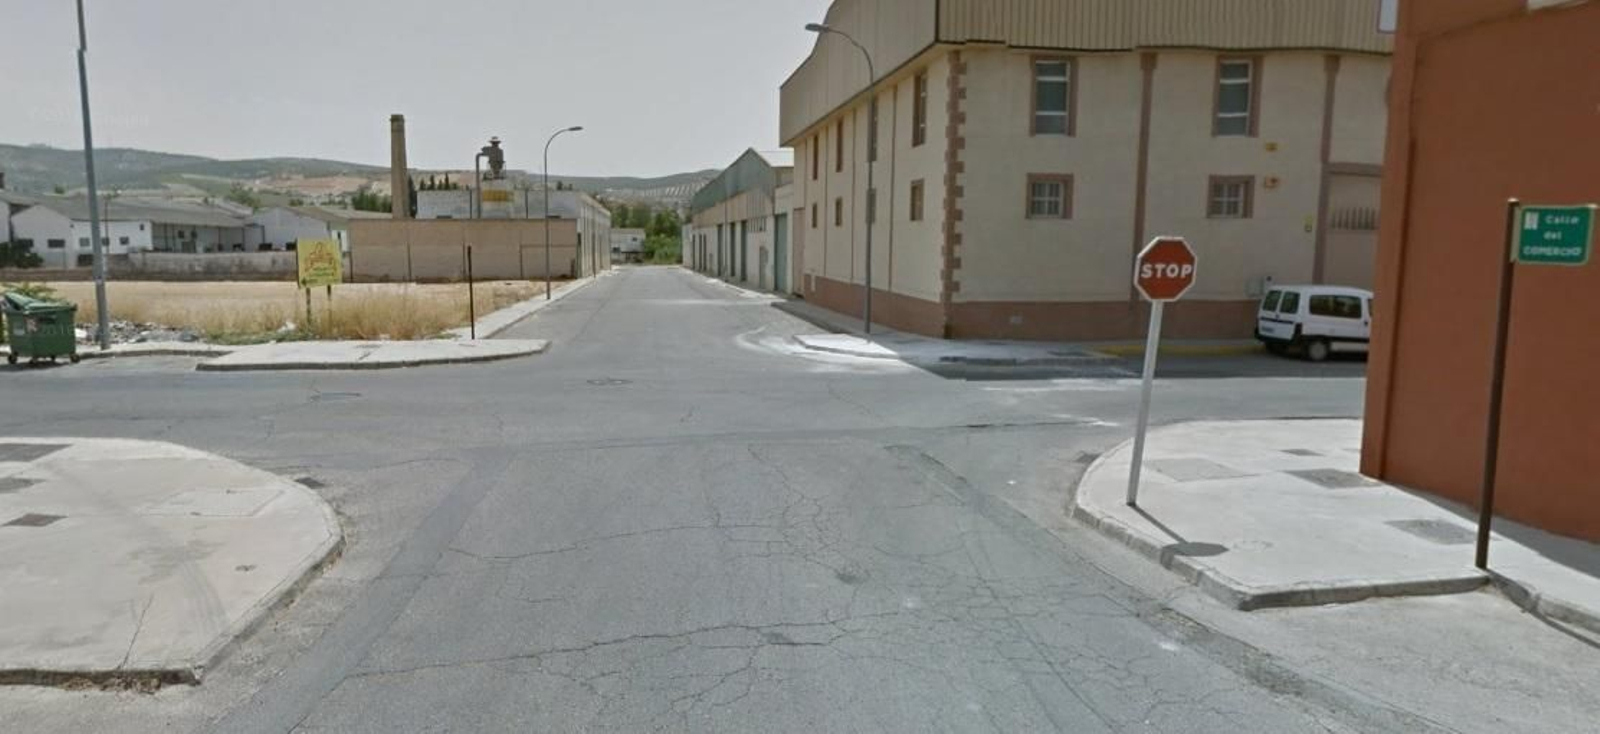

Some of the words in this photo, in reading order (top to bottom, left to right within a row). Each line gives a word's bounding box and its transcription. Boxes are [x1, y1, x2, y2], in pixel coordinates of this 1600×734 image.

[1543, 230, 1562, 240] del
[1523, 245, 1582, 256] COMERCIO
[1140, 263, 1193, 279] STOP
